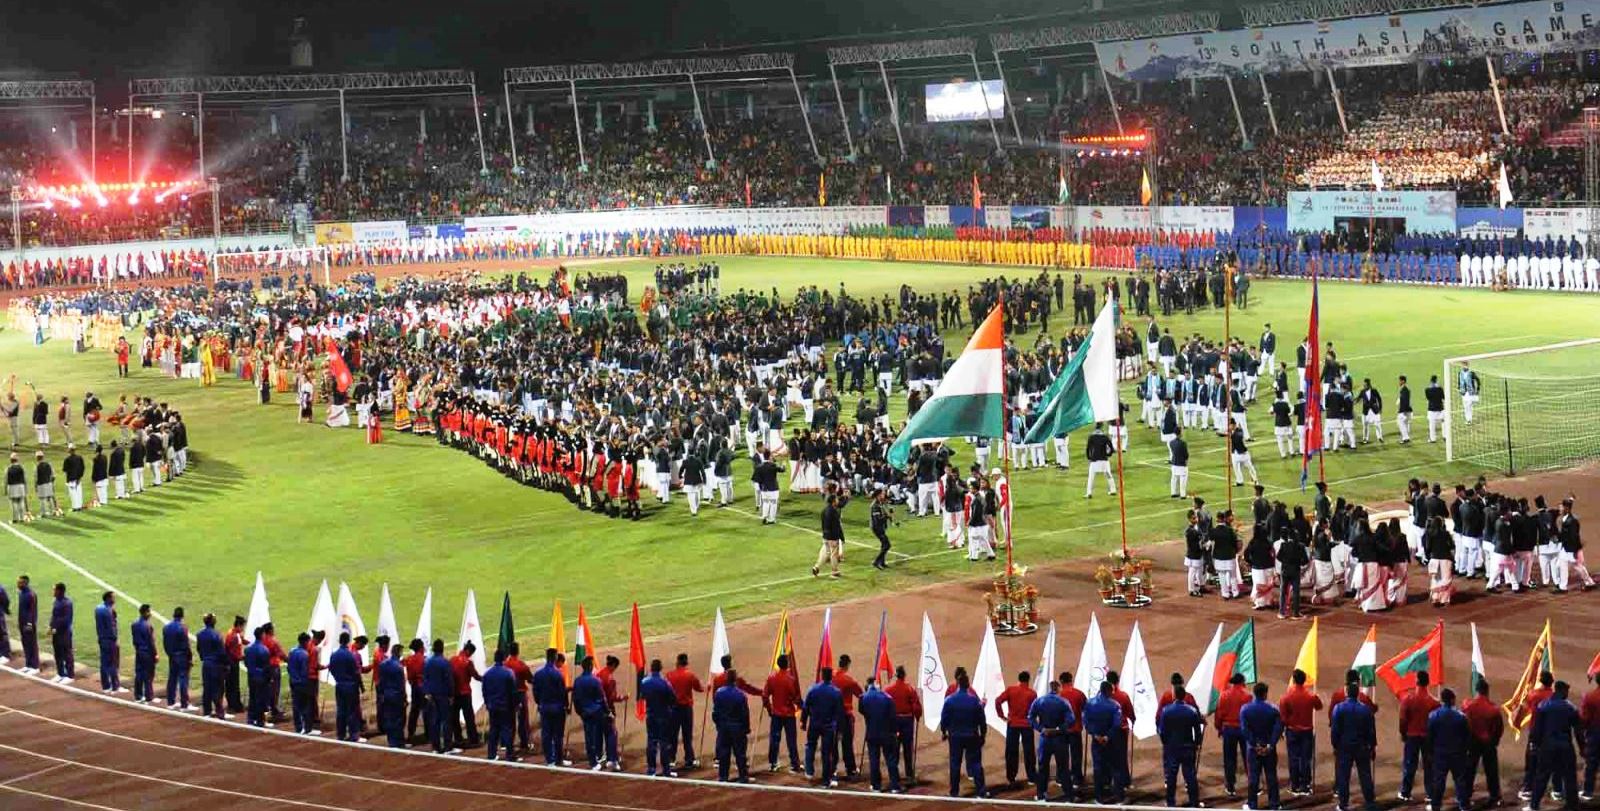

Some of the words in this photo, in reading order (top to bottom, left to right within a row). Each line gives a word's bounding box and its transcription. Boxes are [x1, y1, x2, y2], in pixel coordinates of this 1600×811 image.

[1230, 37, 1325, 58] SOUTH
[1358, 26, 1458, 47] ASIAN
[1493, 13, 1593, 36] GAME
